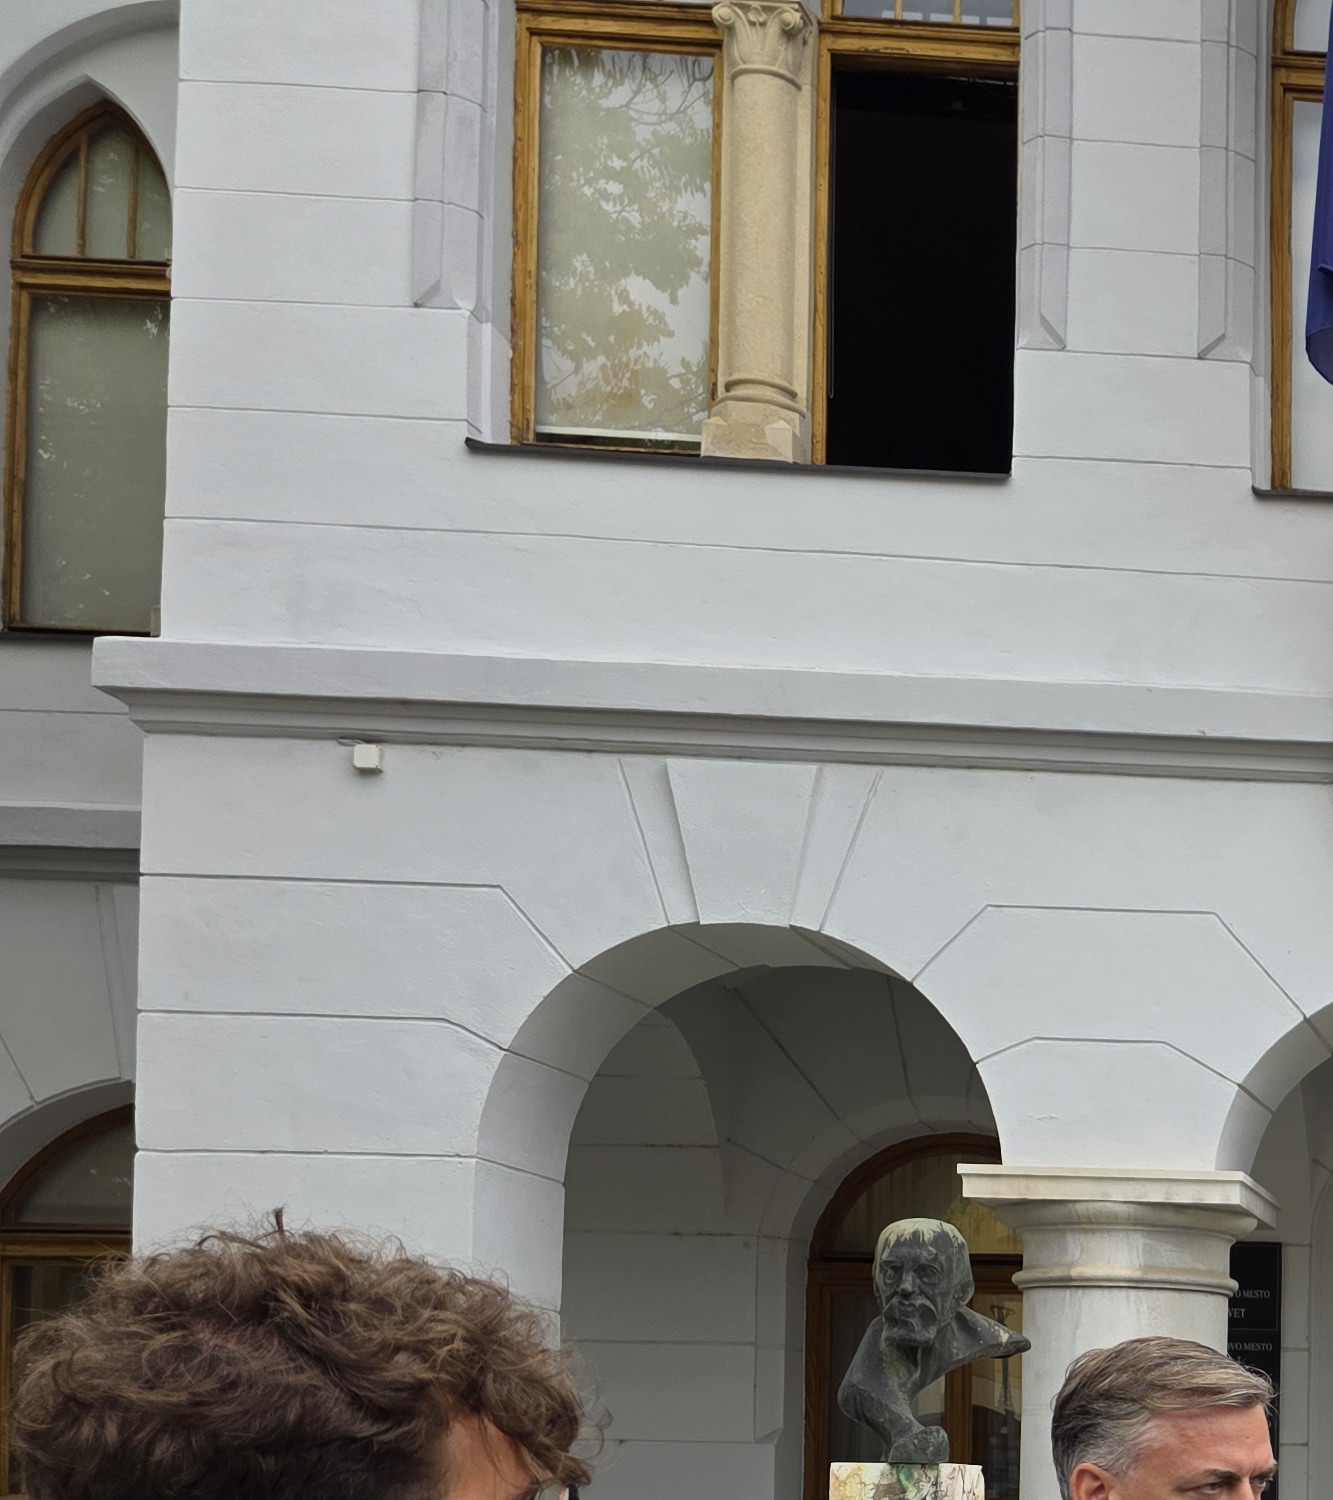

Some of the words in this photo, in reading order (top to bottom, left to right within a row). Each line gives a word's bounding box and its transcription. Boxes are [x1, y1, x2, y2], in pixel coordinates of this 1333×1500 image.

[1243, 1289, 1271, 1299] MESTO
[1228, 1307, 1246, 1319] VET
[1243, 1342, 1273, 1351] MESTO
